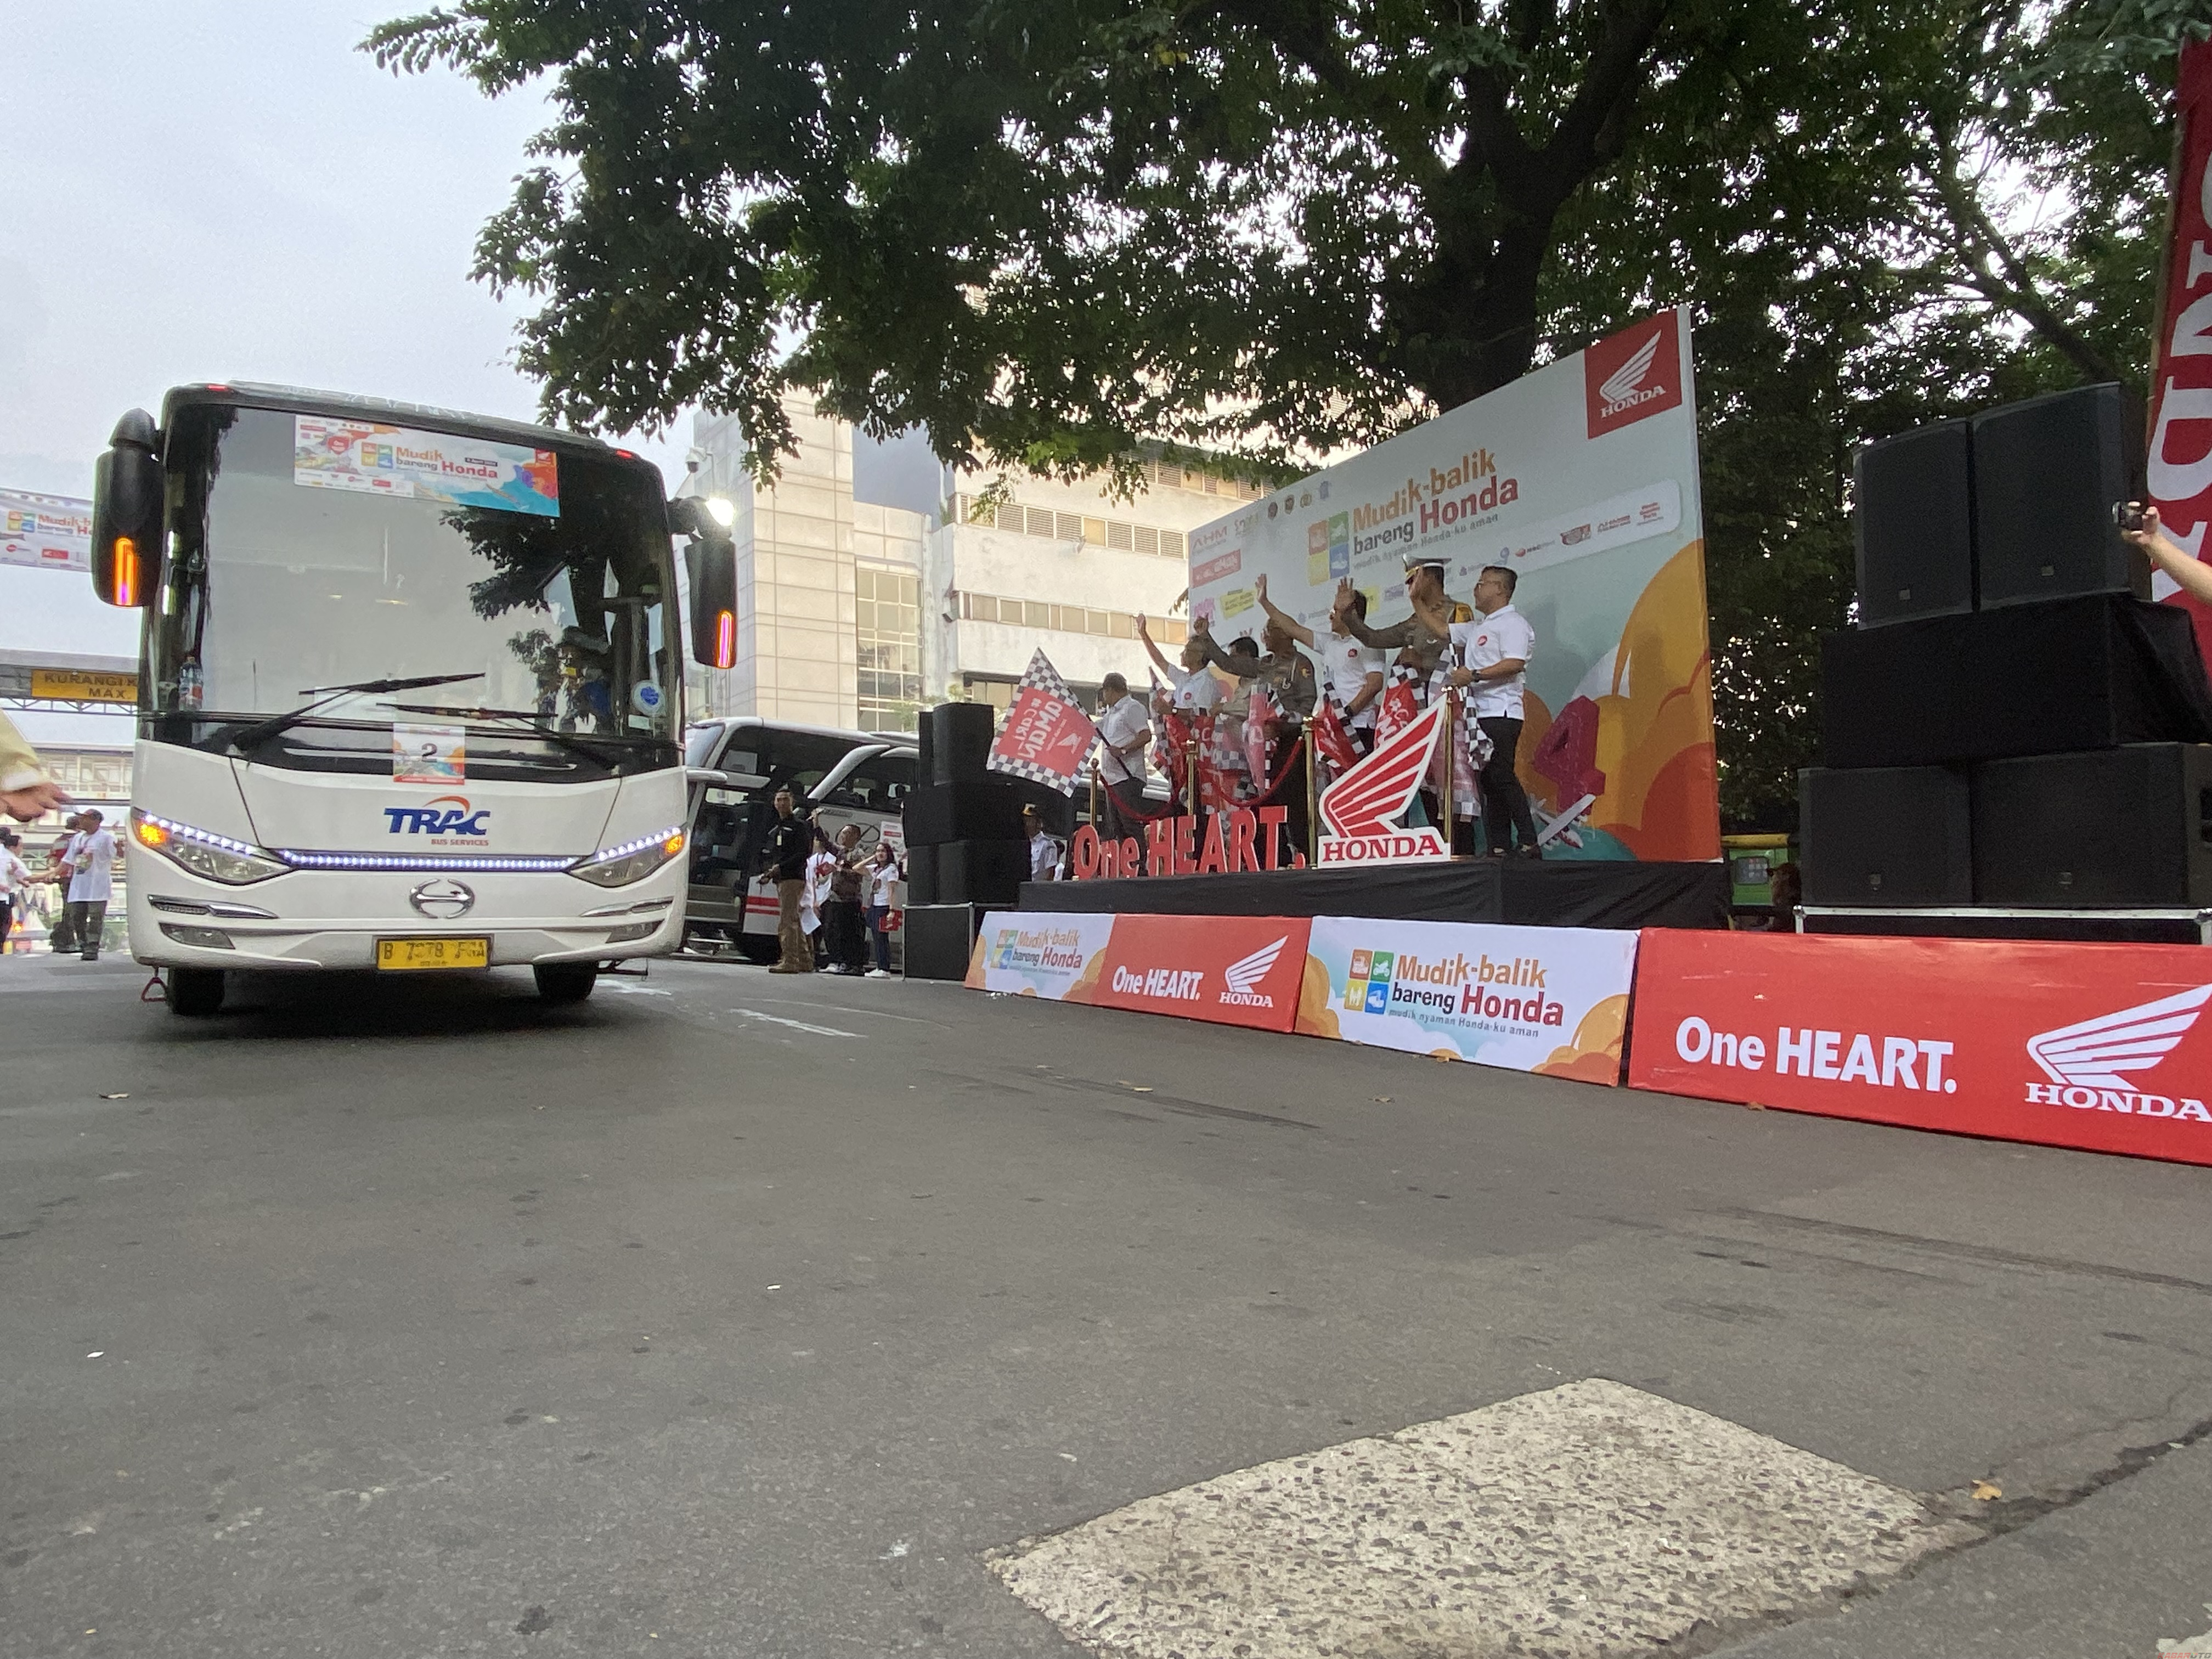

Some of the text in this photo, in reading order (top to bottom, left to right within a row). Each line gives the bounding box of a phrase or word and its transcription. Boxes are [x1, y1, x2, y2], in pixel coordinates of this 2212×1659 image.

[1600, 386, 1666, 419] HONDA
[396, 447, 443, 460] Mudik
[396, 458, 438, 471] bareng
[442, 461, 498, 479] Honda
[1353, 448, 1497, 532] Mudik-balik
[1354, 475, 1519, 555] bareng Honda
[44, 673, 122, 686] KURANGI
[421, 743, 437, 763] 2
[383, 808, 491, 835] TRAC
[1074, 805, 1306, 879] One HEART.
[1322, 835, 1443, 862] HONDA
[1013, 947, 1082, 969] bareng Honda
[1395, 952, 1548, 989] Mudik-balik
[1113, 966, 1204, 1001] One HEART.
[1219, 992, 1273, 1007] HONDA
[1392, 982, 1564, 1026] bareng Honda
[1389, 1008, 1538, 1037] mudik nyaman Honda-ku aman
[1675, 1017, 1957, 1094] One HEART.
[2025, 1082, 2212, 1122] HONDA
